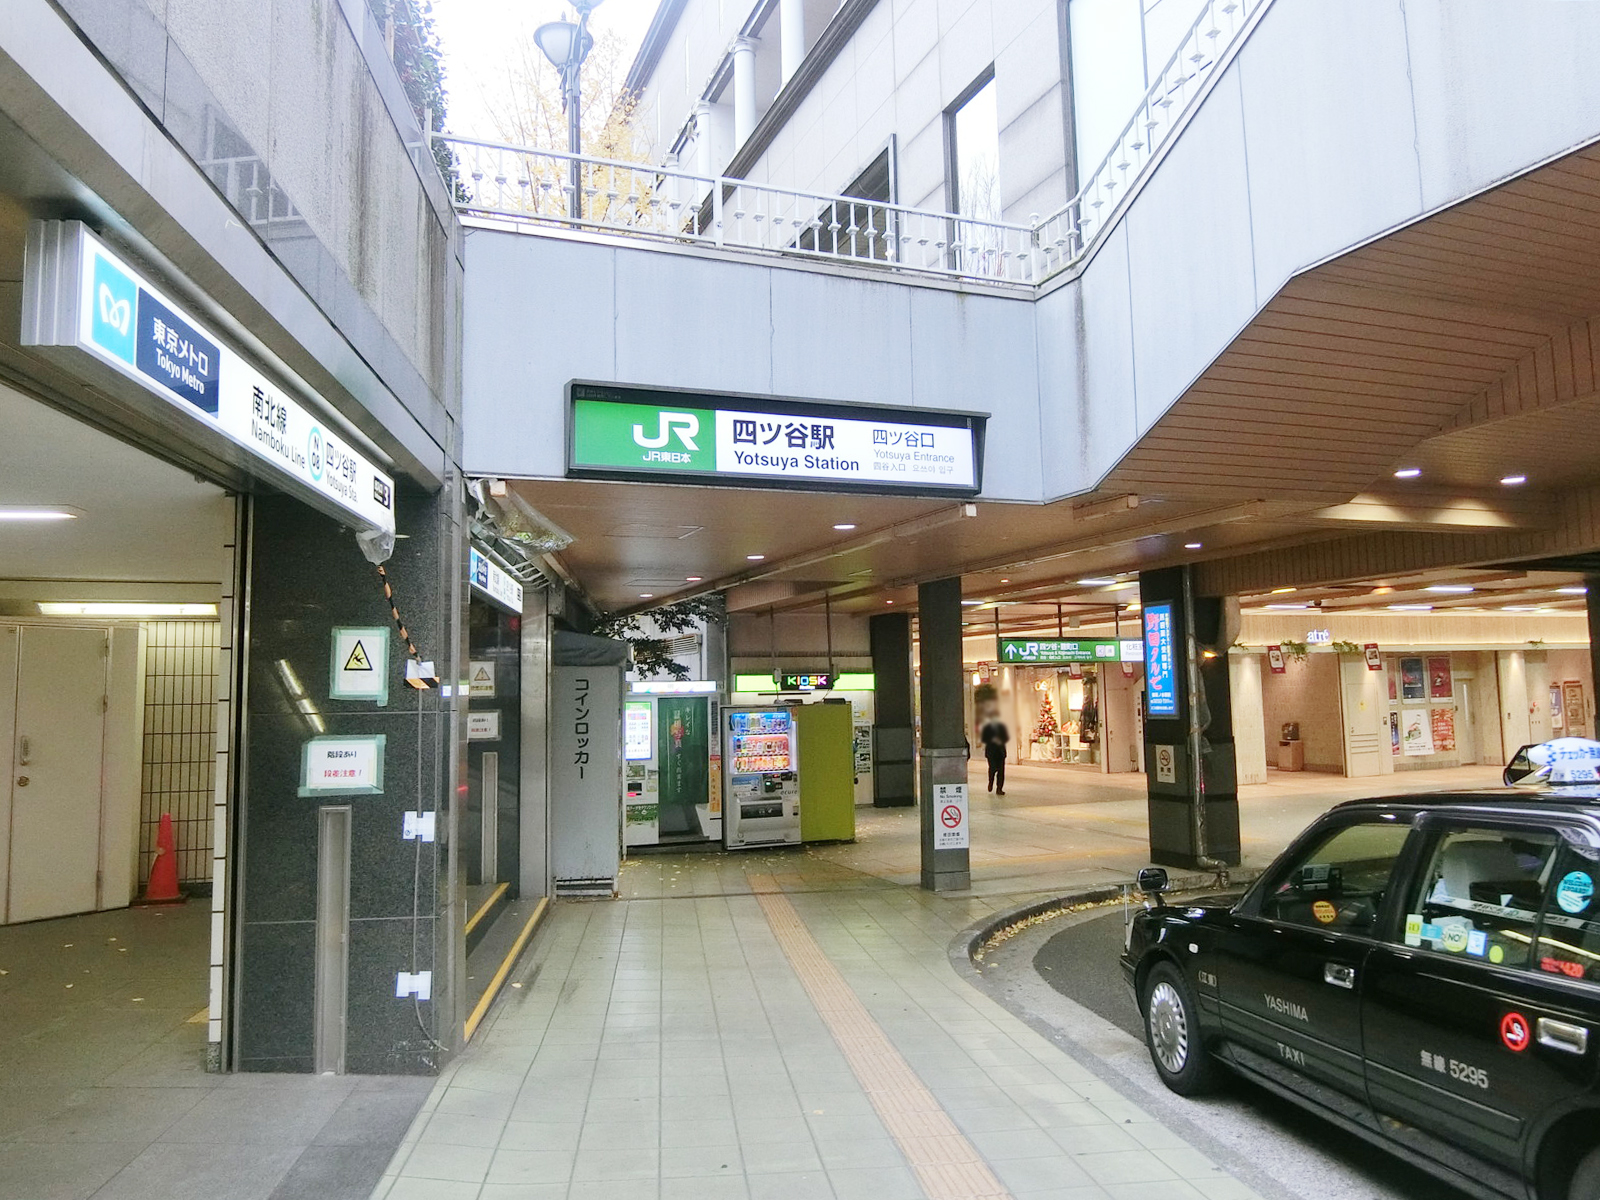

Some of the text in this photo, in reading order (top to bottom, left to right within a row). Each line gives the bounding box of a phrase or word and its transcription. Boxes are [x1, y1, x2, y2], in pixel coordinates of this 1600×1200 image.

[153, 316, 208, 376] 東京メトロ
[156, 348, 205, 394] Tokyo Metro
[253, 385, 287, 434] 南北線
[251, 418, 306, 469] Namboku Line
[632, 411, 700, 451] JR
[733, 419, 835, 450] 四ツ谷駅
[873, 429, 935, 448] 四ツ谷口
[326, 441, 357, 484] 四ツ谷駅
[642, 450, 691, 464] JR東日本
[734, 450, 860, 471] Yotsuya Station
[873, 449, 955, 463] Yotsuya Entrance
[1019, 642, 1039, 656] JR
[787, 676, 827, 686] KIOSK
[574, 679, 589, 779] コインロッカー
[327, 750, 357, 758] 階段あり
[1264, 993, 1309, 1022] YASHIMA
[1277, 1042, 1305, 1066] TAXI
[1449, 1059, 1489, 1089] 5295
